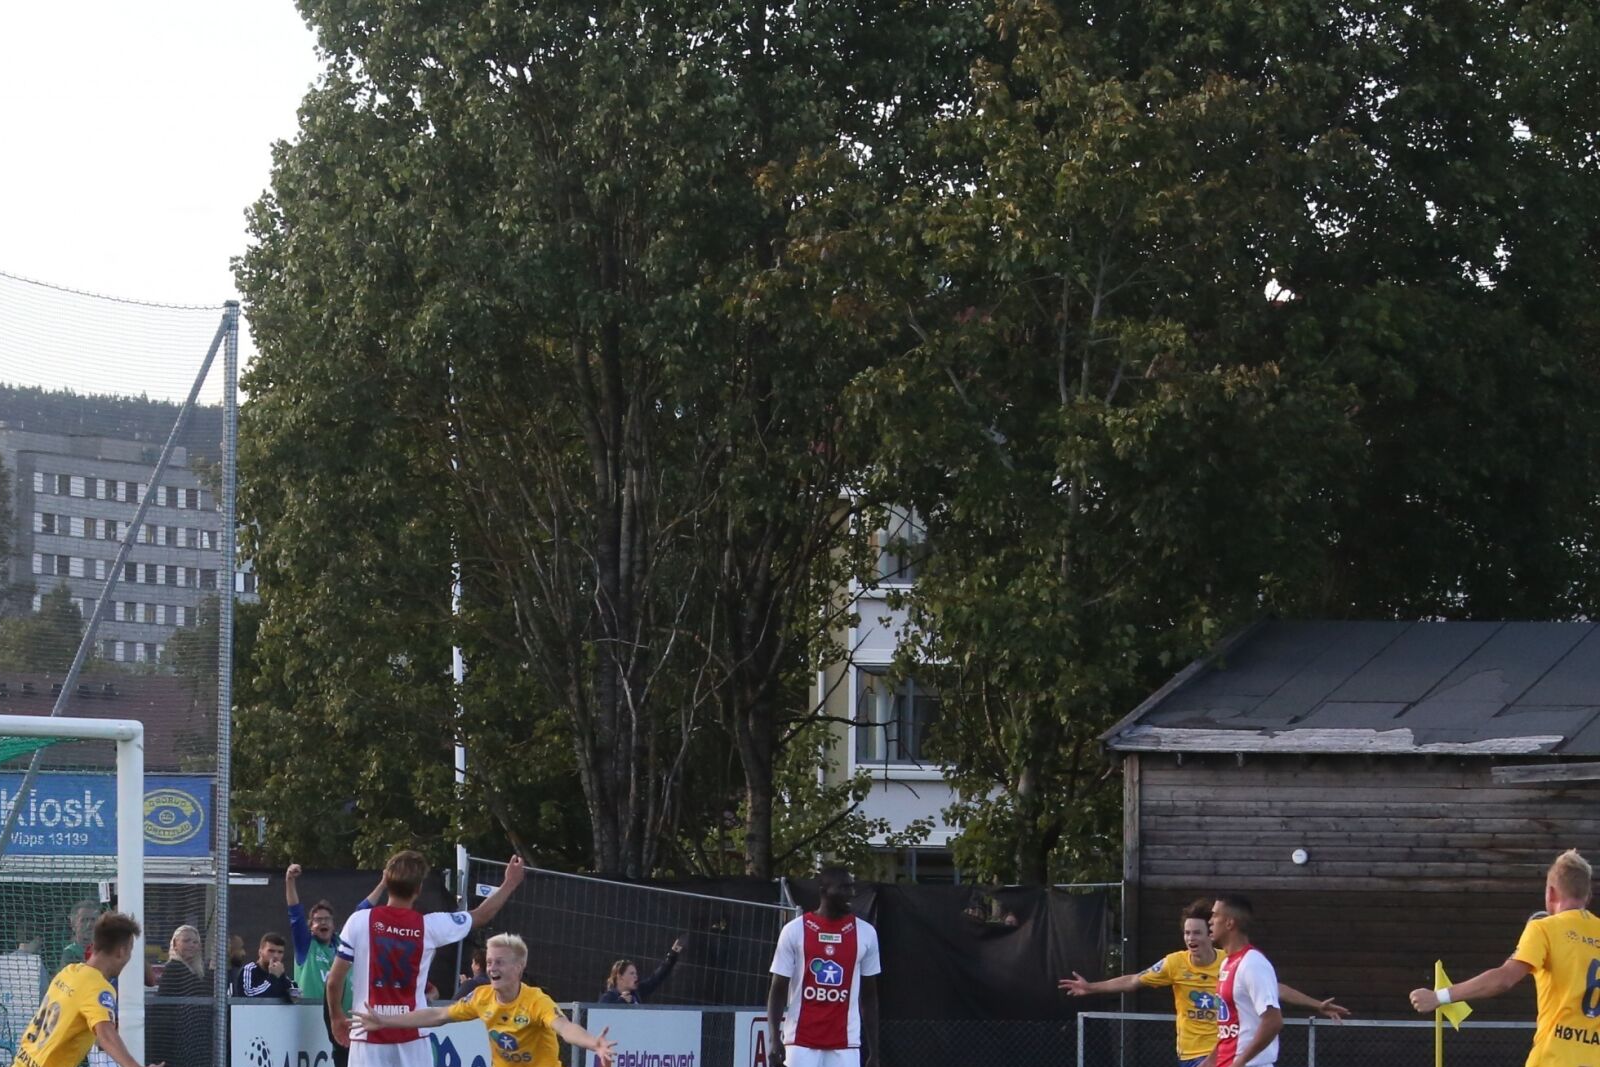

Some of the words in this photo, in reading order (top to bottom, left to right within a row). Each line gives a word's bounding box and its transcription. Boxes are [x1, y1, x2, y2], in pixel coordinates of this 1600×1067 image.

[1, 788, 105, 828] Kiosk
[49, 832, 89, 847] 13139
[386, 925, 421, 938] ARCTIC
[804, 986, 848, 1003] OBOS
